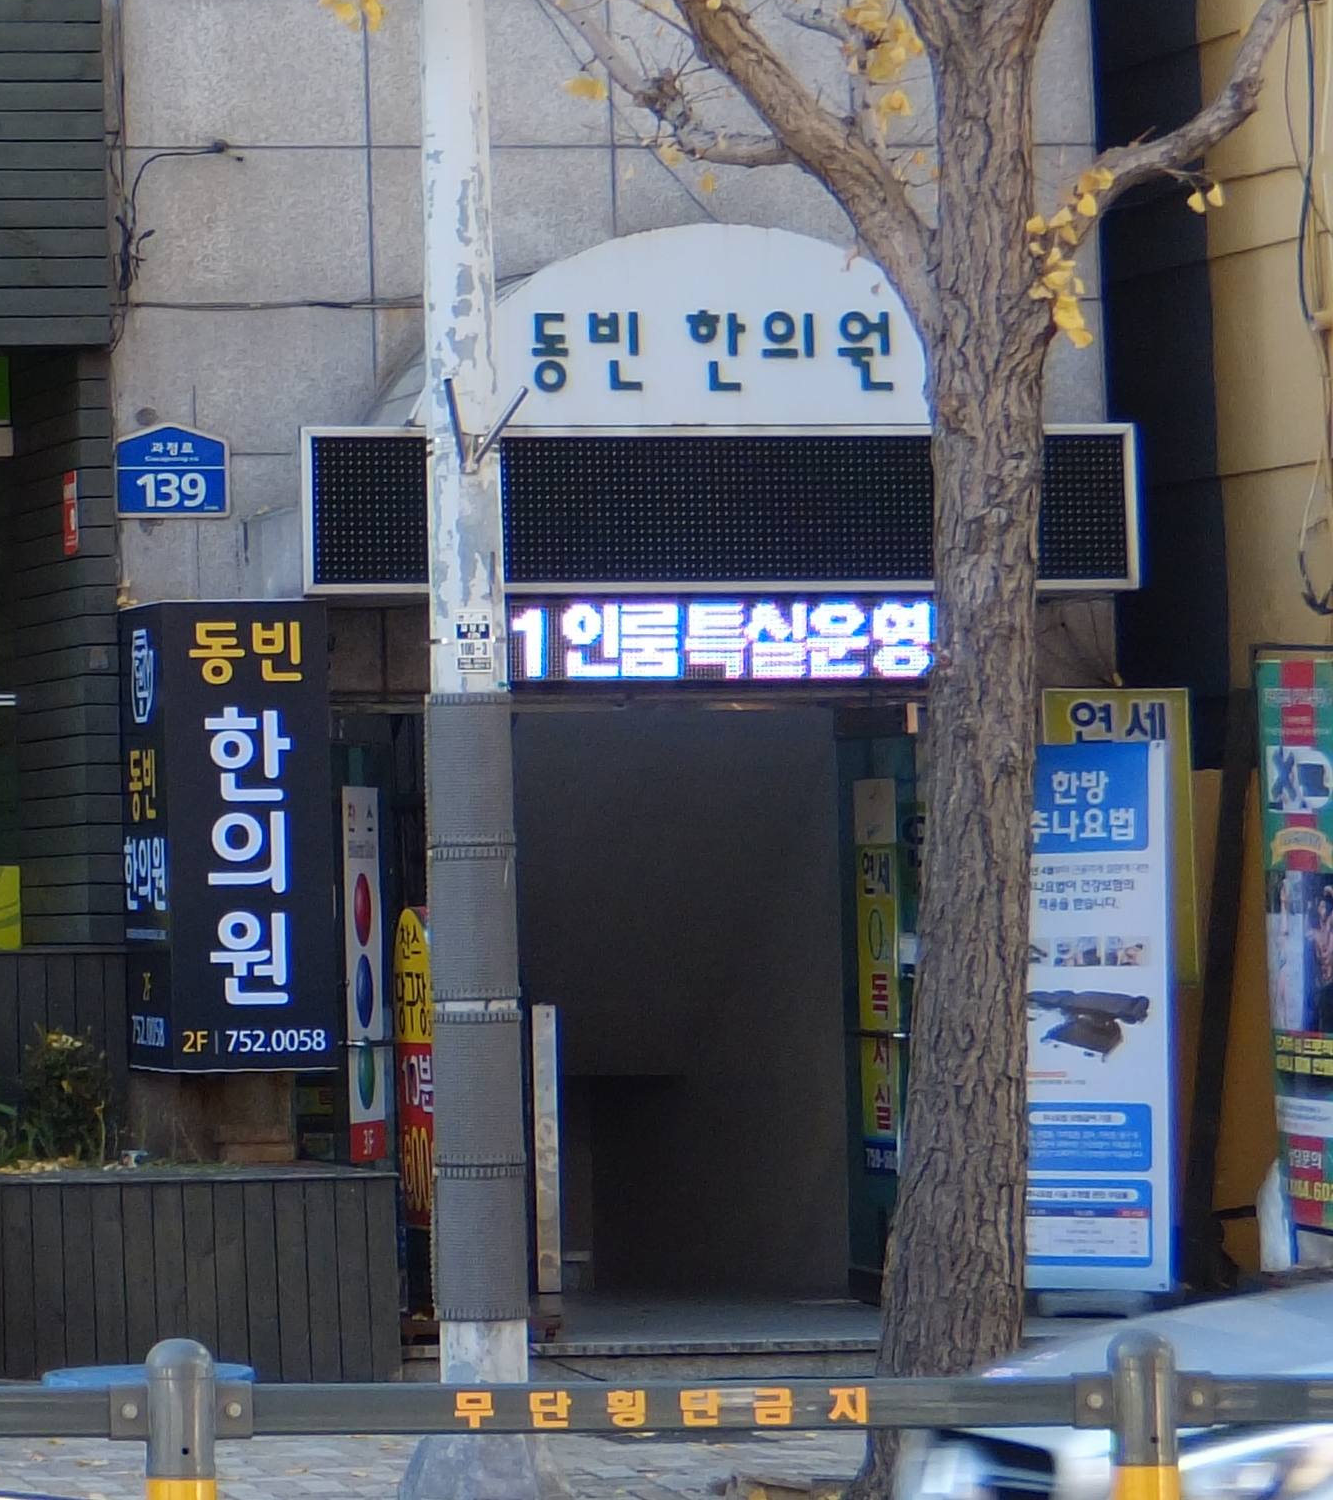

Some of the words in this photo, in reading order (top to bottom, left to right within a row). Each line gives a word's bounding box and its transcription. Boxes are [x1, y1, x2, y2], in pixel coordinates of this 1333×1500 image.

[531, 310, 644, 393] 동빈
[684, 308, 895, 393] 한의원
[135, 472, 207, 509] 139
[187, 619, 303, 686] 동빈
[1069, 700, 1167, 743] 연세
[1051, 769, 1110, 805] 한방
[1030, 806, 1136, 845] 추나요법
[203, 703, 293, 1007] 한의원
[180, 1029, 209, 1054] 2F
[224, 1028, 328, 1054] 752.0058
